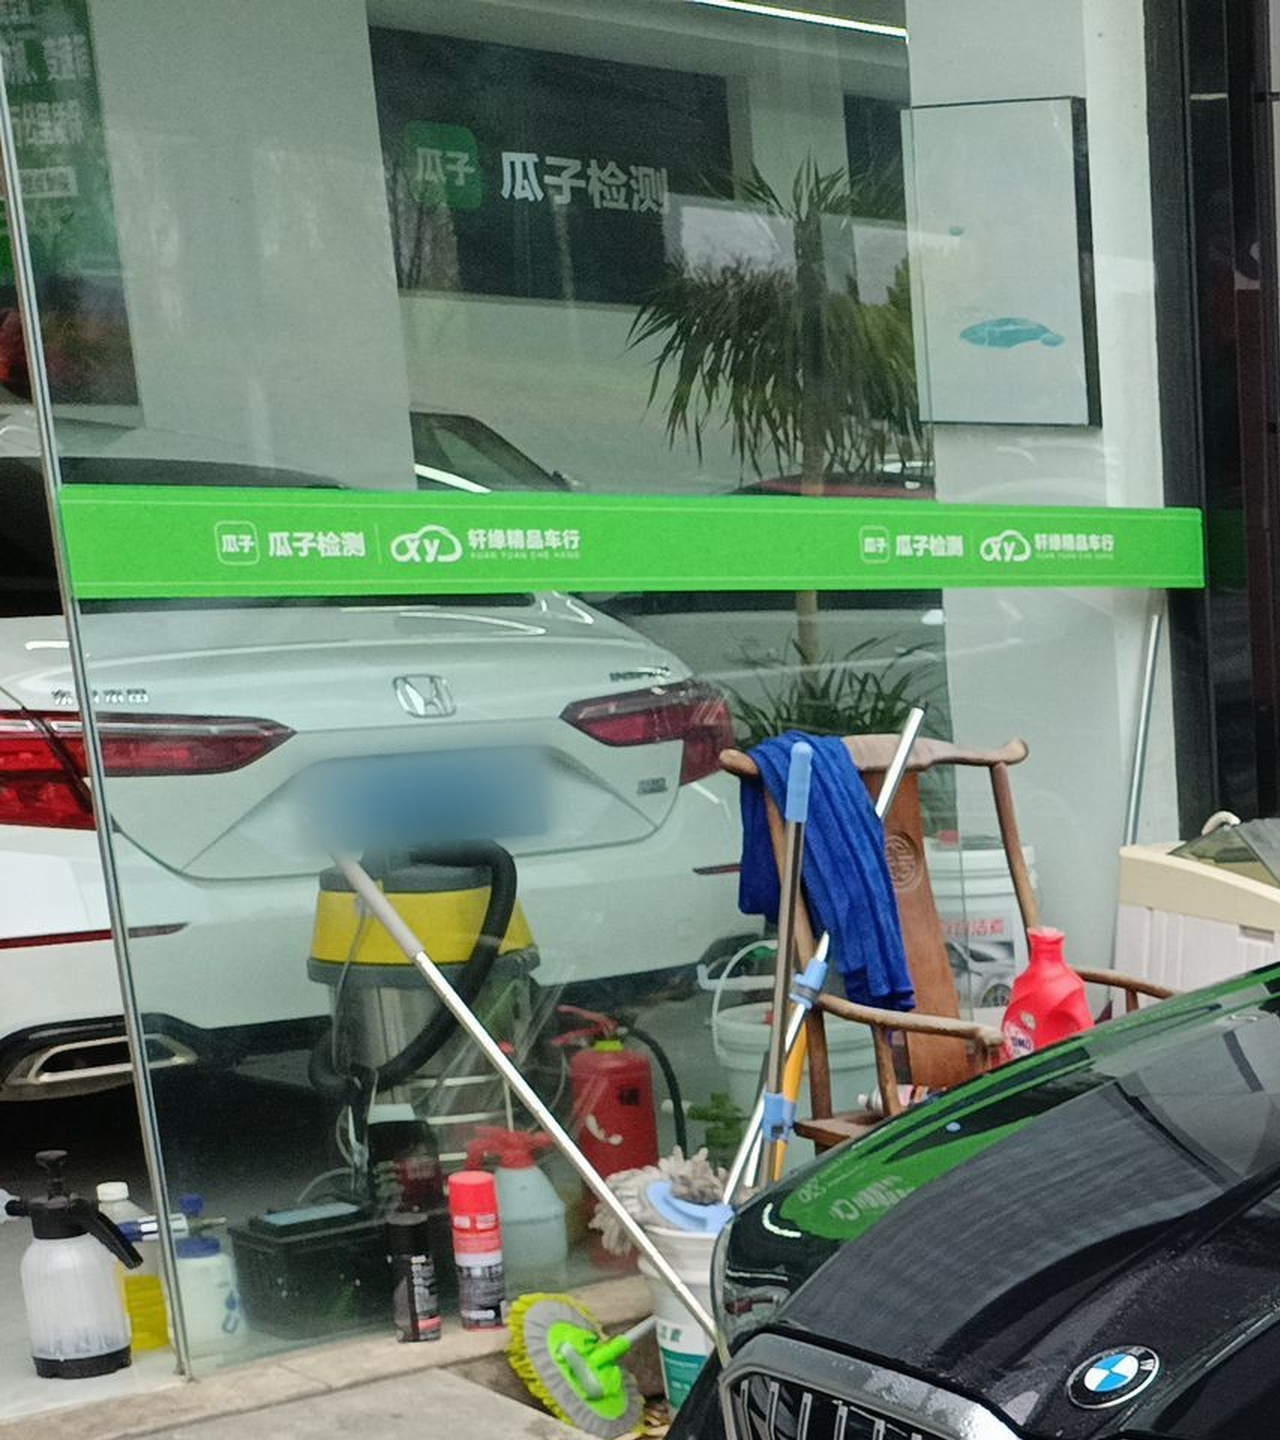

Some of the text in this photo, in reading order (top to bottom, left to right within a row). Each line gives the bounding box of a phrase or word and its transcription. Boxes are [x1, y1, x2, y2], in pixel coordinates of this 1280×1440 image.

[415, 148, 476, 186] 瓜子
[500, 151, 668, 214] 瓜子检测
[221, 534, 255, 553] 瓜子
[268, 531, 366, 558] 瓜子检测
[467, 528, 581, 551] 轩缘精品车行
[896, 535, 964, 558] 瓜子检测
